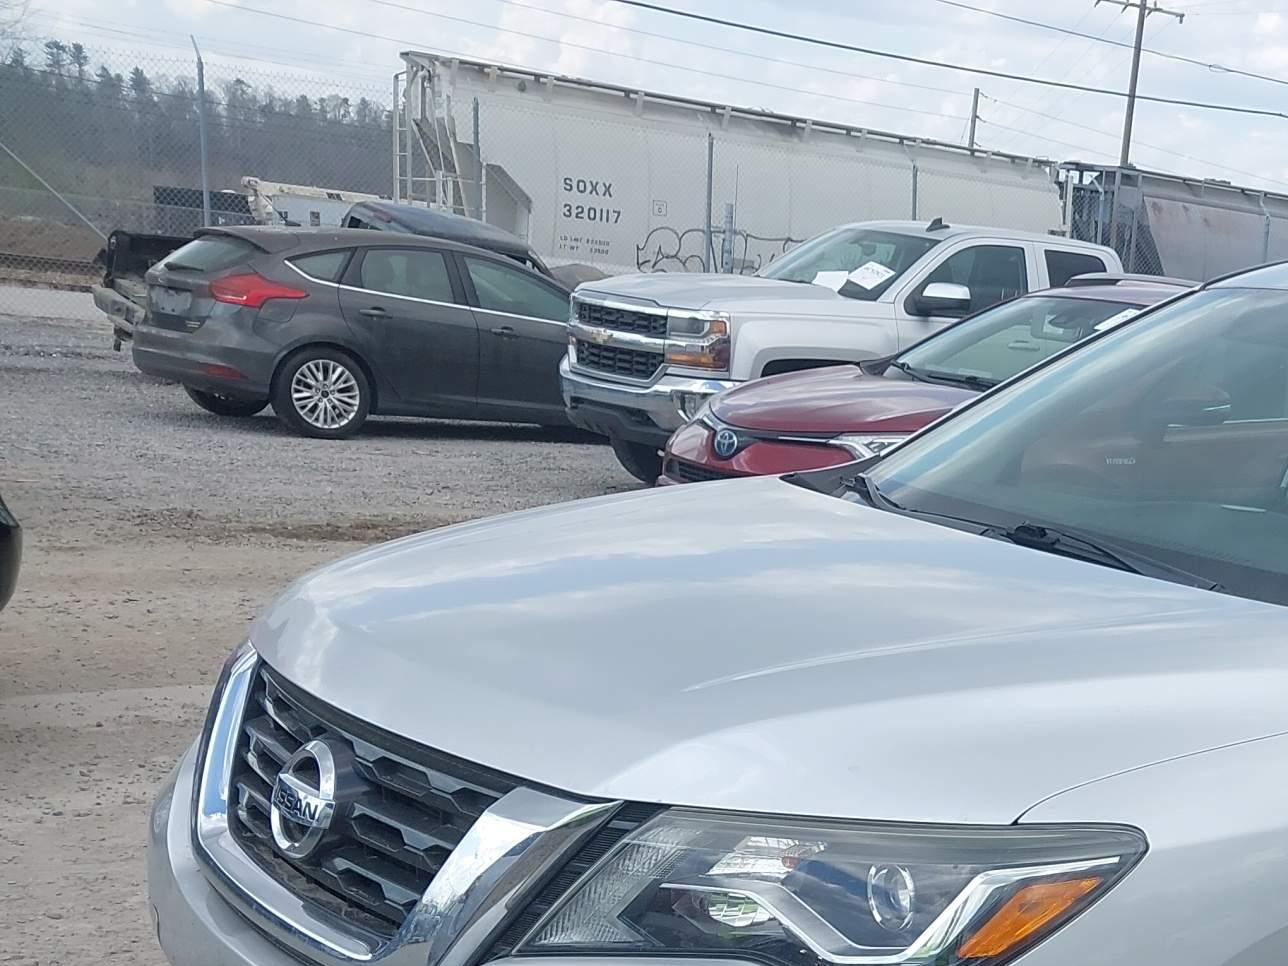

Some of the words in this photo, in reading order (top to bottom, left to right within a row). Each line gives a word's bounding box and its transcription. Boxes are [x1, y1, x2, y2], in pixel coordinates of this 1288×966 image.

[563, 177, 613, 198] SOXX
[562, 203, 621, 224] 320117
[273, 785, 319, 821] ISSAN
